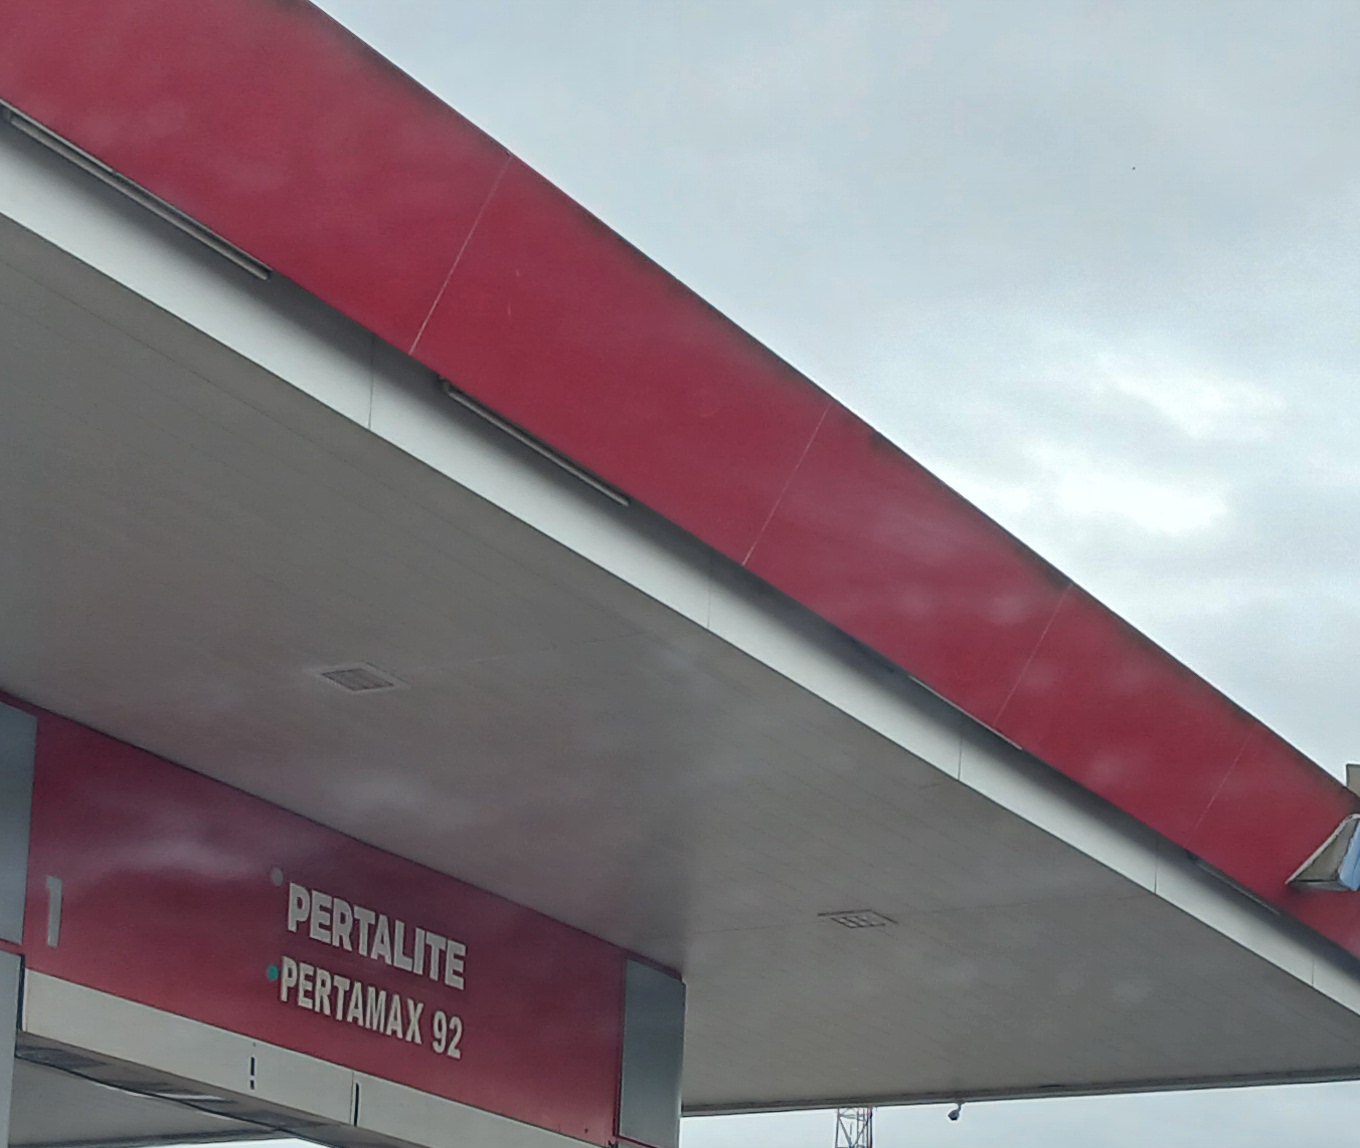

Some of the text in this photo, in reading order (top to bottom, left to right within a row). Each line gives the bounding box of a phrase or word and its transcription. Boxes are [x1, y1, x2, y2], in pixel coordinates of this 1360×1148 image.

[46, 875, 63, 948] 1
[287, 882, 467, 990] PERTALITE
[280, 956, 464, 1060] PERTAMAX 92
